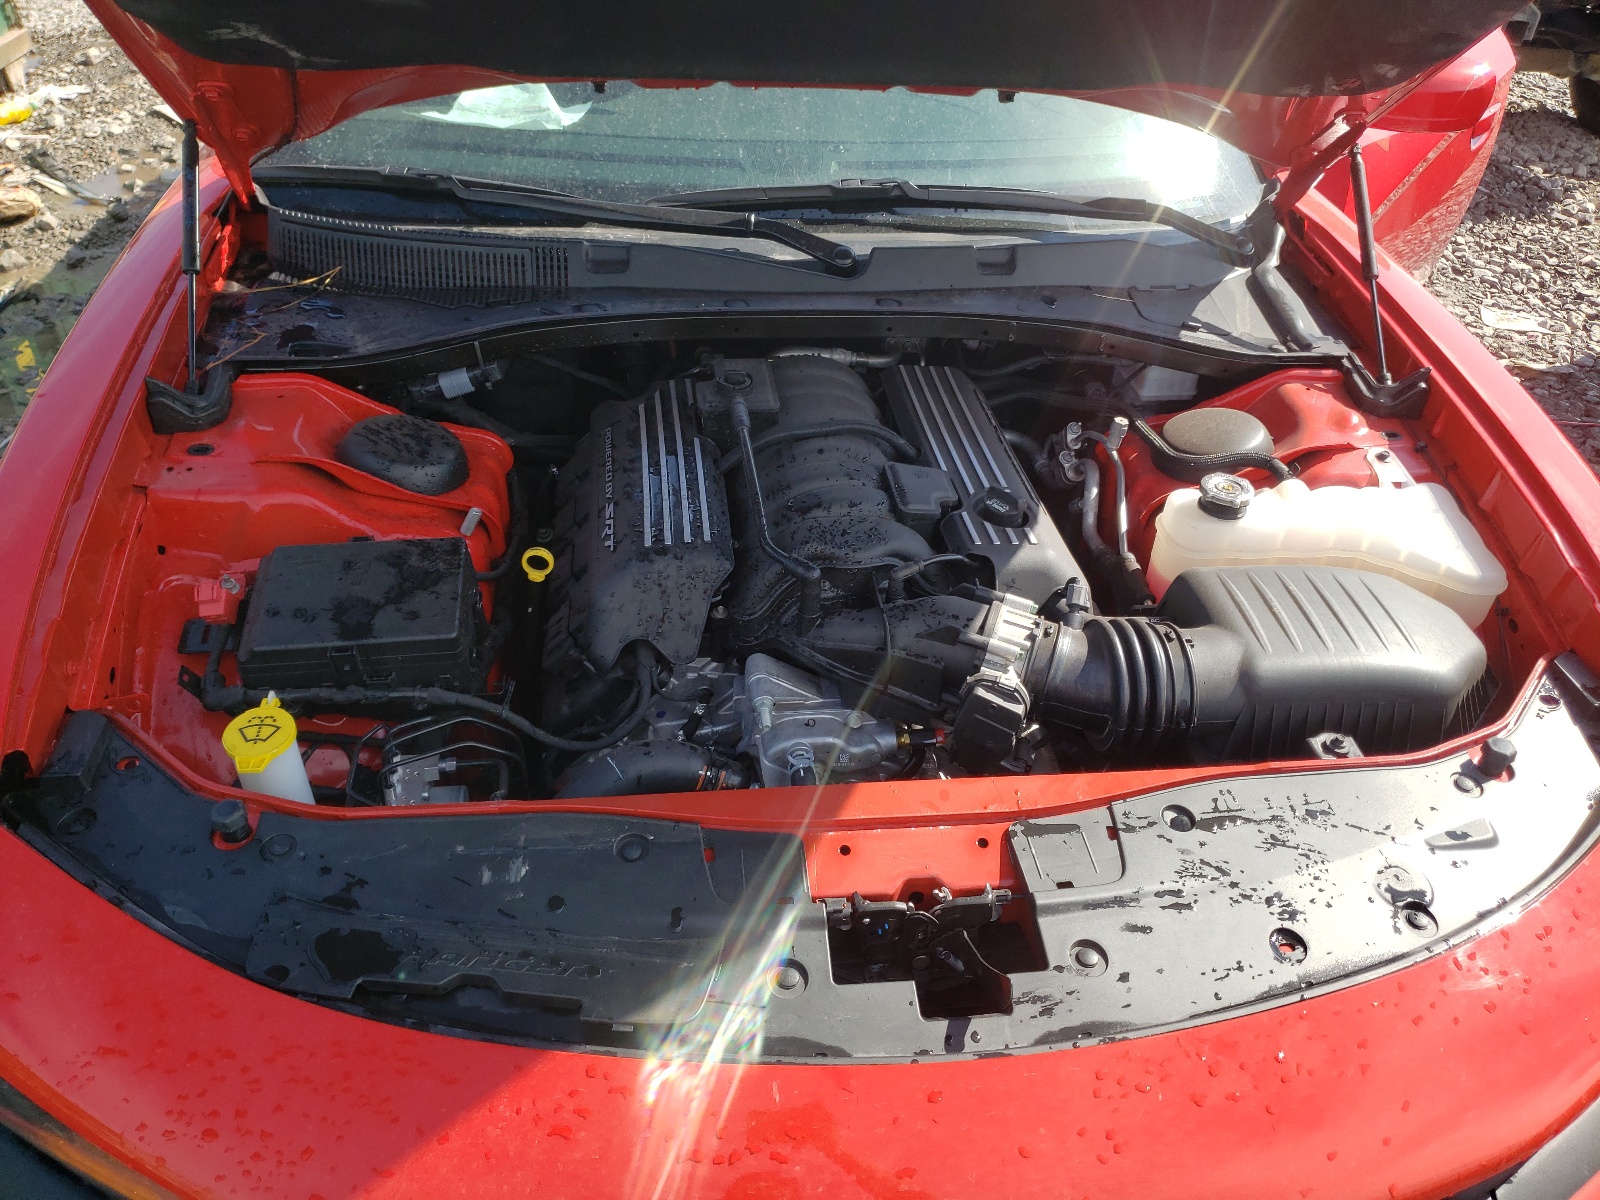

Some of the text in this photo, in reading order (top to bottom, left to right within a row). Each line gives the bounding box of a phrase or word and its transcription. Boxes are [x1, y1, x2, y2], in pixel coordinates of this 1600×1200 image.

[602, 427, 615, 551] POWERED BY SRT
